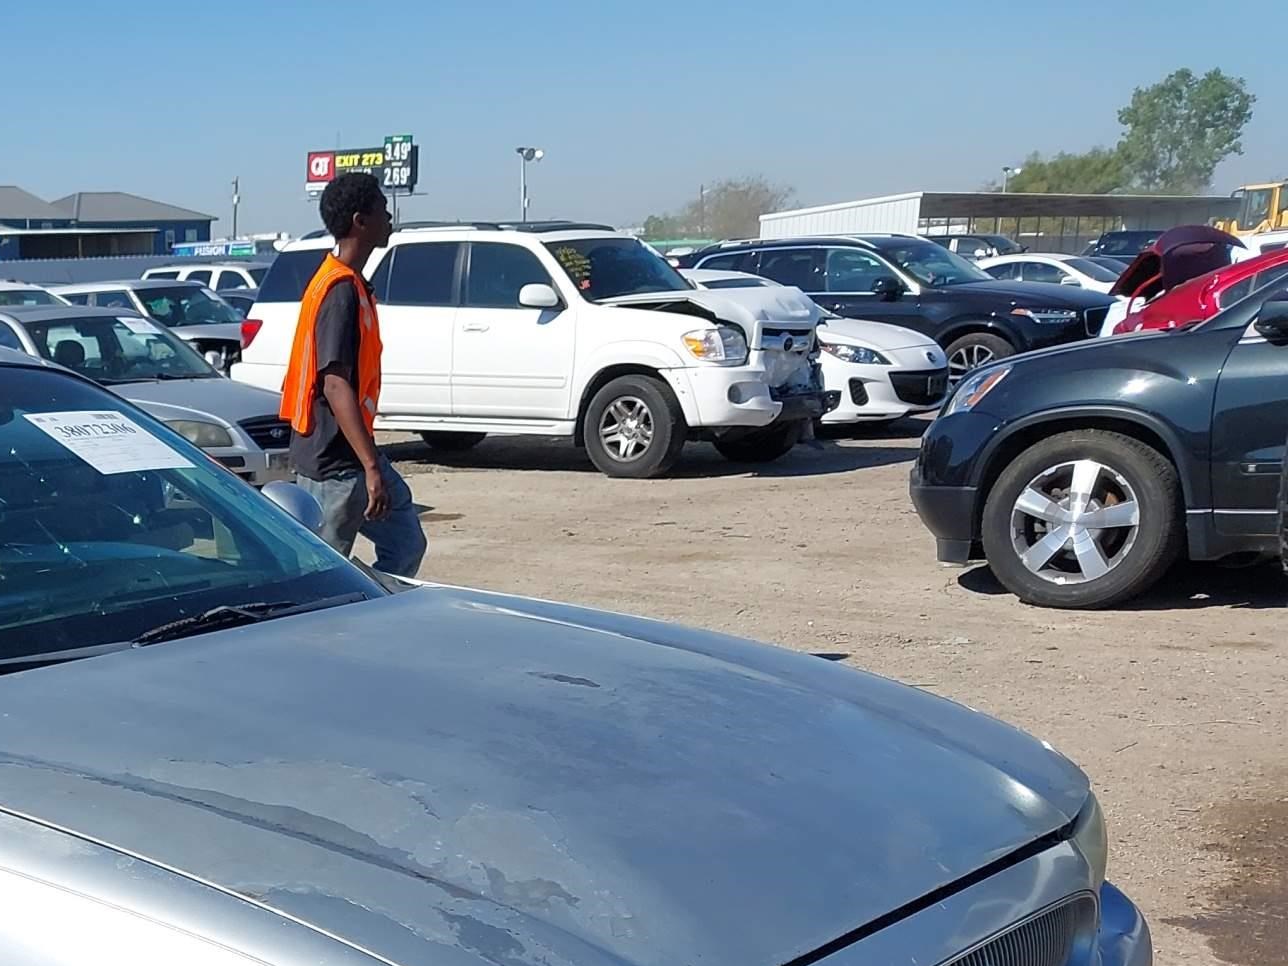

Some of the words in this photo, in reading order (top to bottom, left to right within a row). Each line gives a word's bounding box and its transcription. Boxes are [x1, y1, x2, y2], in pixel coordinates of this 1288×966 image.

[310, 157, 330, 176] QT
[335, 155, 360, 167] EXIT
[361, 152, 383, 165] 273
[194, 246, 225, 256] FUSION
[54, 423, 137, 438] 38072306
